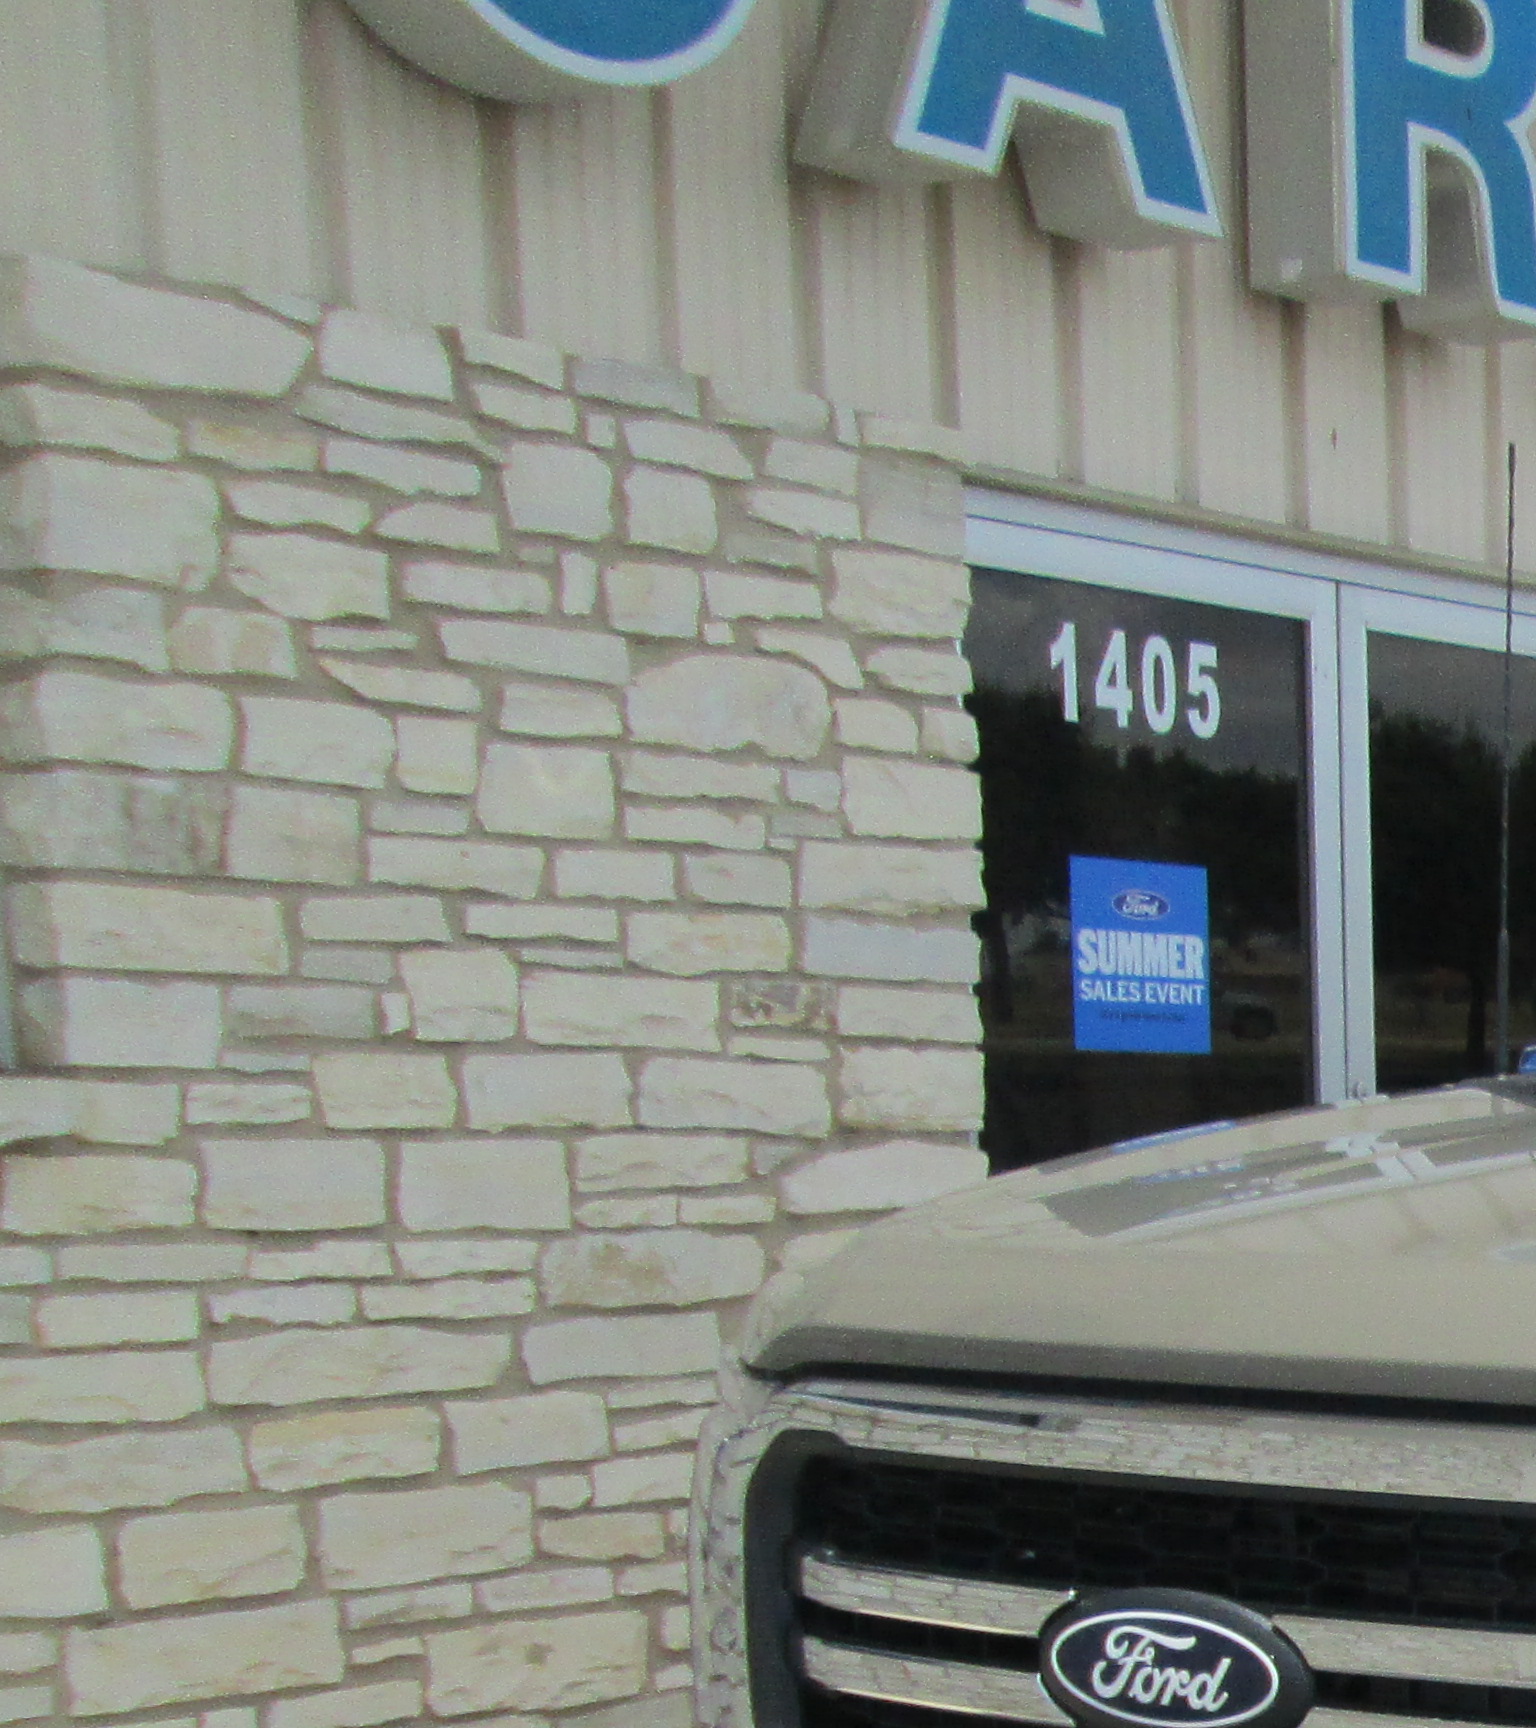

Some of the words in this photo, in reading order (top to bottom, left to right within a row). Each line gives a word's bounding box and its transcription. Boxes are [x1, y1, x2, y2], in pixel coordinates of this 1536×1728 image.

[1050, 621, 1221, 739] 1405
[1077, 928, 1204, 980] SUMMER
[1079, 979, 1141, 1002] SALES
[1144, 983, 1204, 1005] EVENT
[1092, 1625, 1232, 1712] Ford
